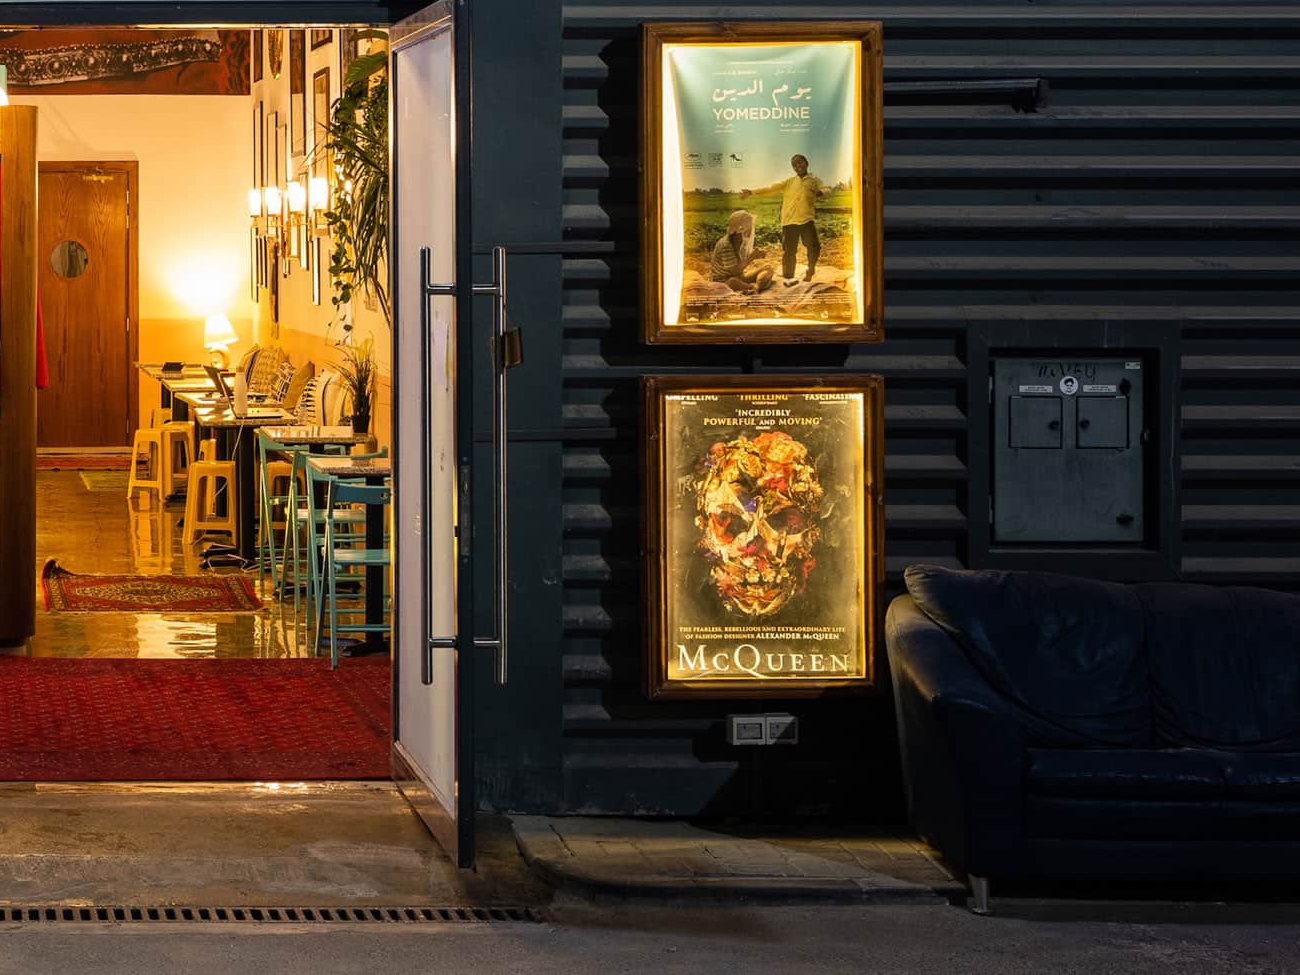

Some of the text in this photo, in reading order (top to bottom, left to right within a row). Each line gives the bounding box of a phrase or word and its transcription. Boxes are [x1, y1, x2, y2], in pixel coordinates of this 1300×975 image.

[712, 106, 811, 121] YOMEDDINE
[703, 417, 757, 426] POWERFUL
[756, 632, 801, 640] ALEXANDER
